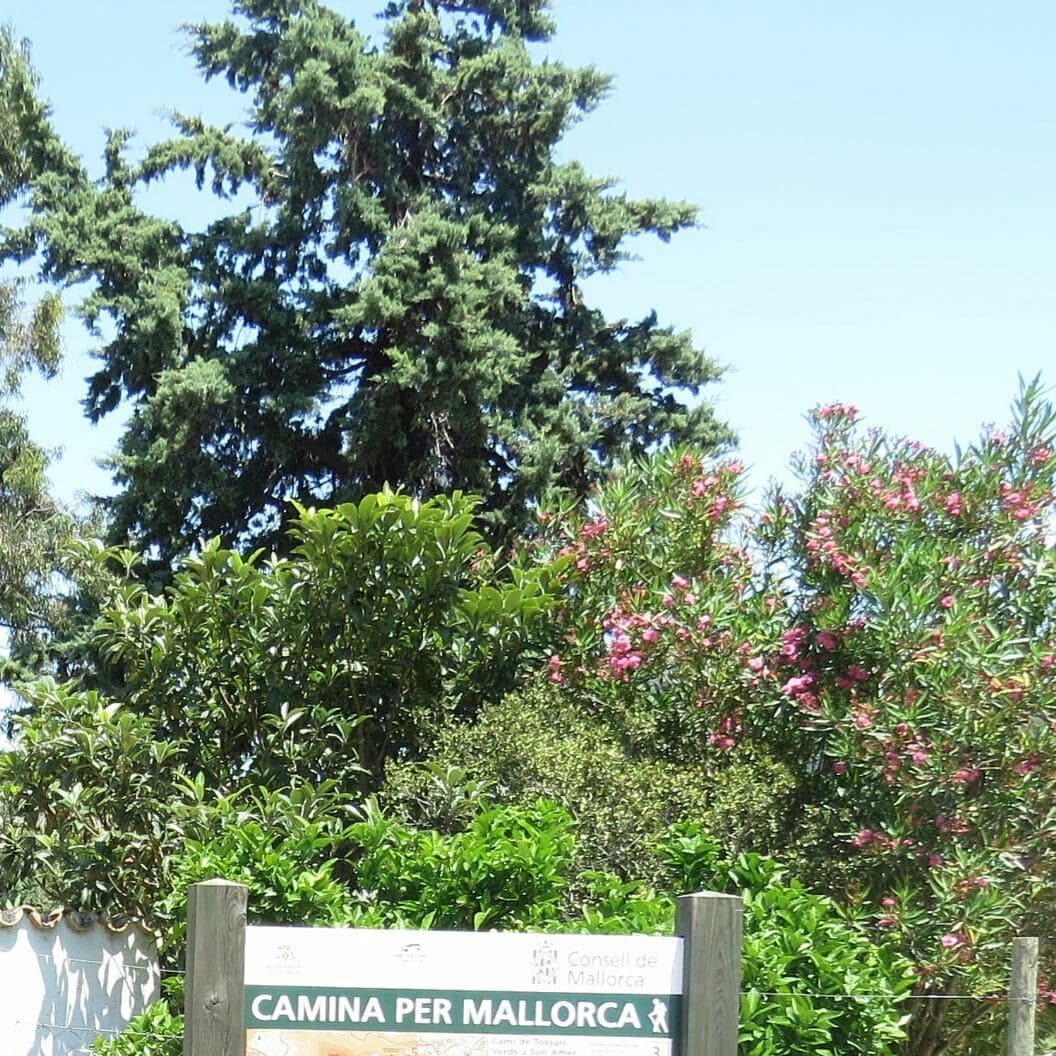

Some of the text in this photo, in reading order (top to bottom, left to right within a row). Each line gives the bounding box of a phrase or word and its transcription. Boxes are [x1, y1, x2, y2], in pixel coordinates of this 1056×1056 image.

[567, 950, 658, 968] Consell de
[567, 969, 645, 987] Mallorca
[251, 993, 642, 1030] CAMINA PER MALLORCA
